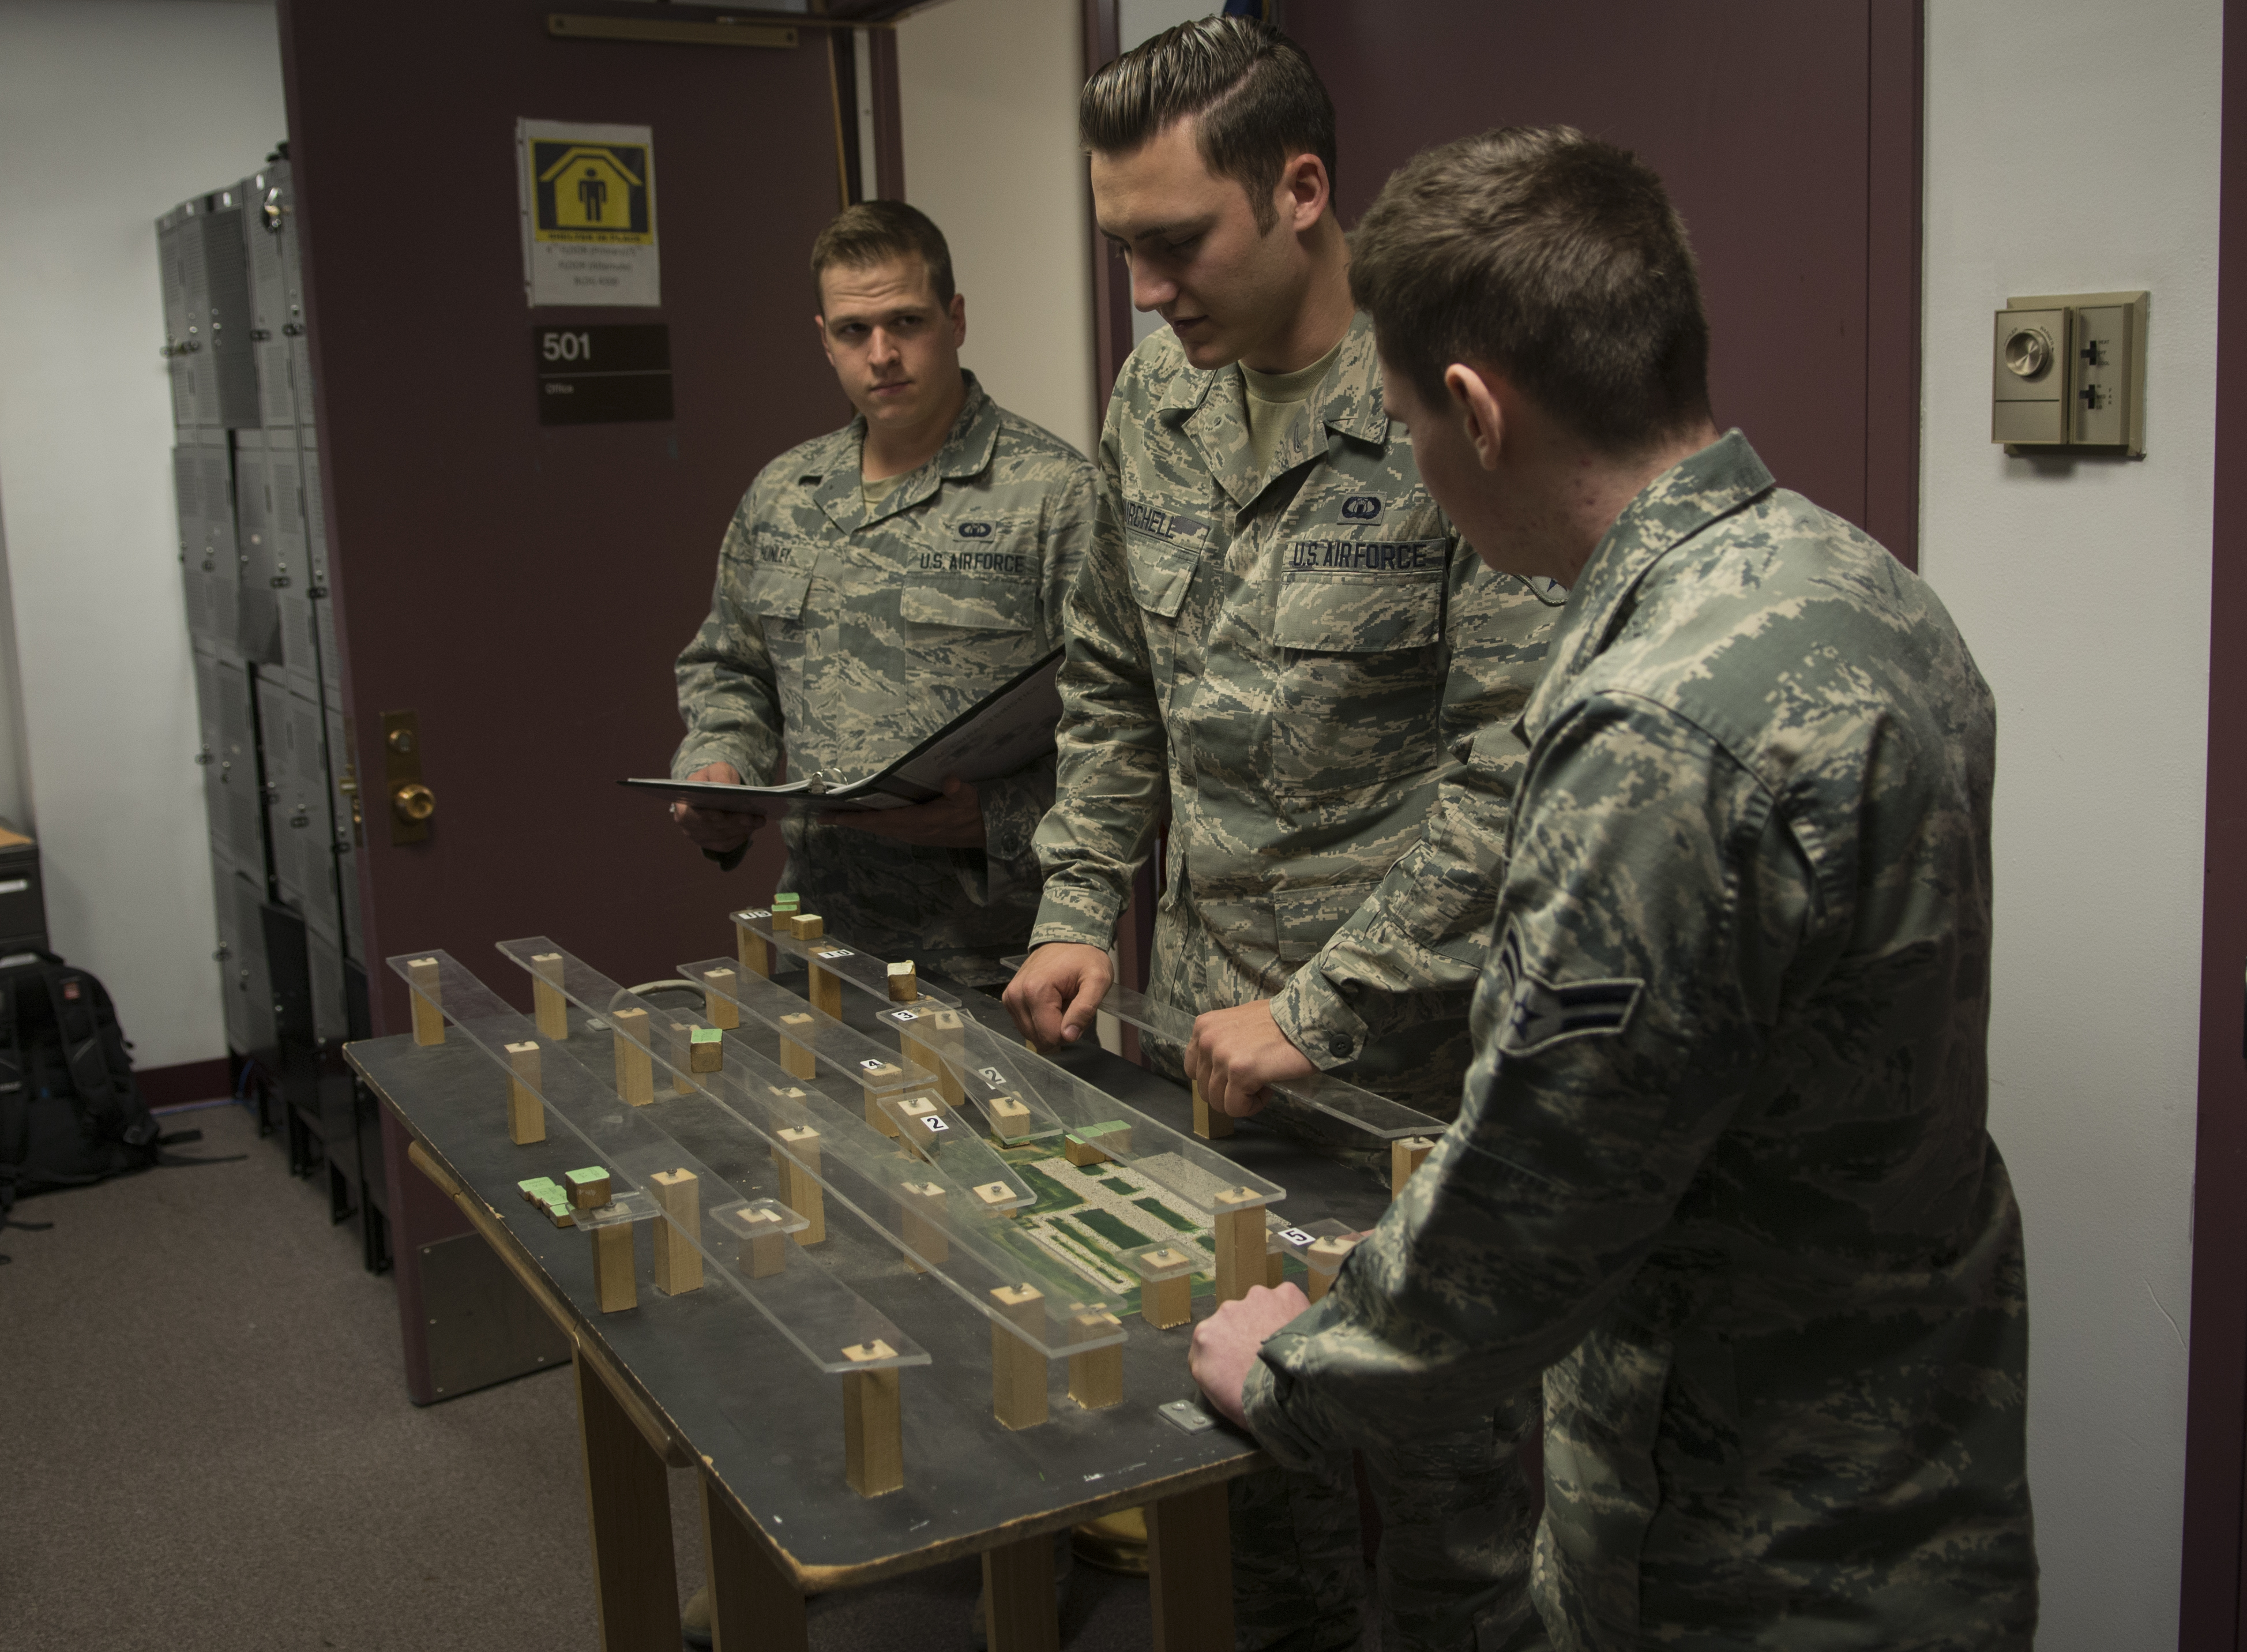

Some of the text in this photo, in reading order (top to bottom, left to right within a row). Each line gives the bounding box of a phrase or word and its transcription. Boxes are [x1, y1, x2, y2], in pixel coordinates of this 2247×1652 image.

[543, 332, 590, 361] 501
[920, 553, 945, 569] U.S.
[1293, 542, 1318, 566] U.S.
[897, 1011, 913, 1019] 3
[985, 1069, 1002, 1084] 2
[927, 1117, 944, 1129] 2
[1285, 1230, 1307, 1242] 5
